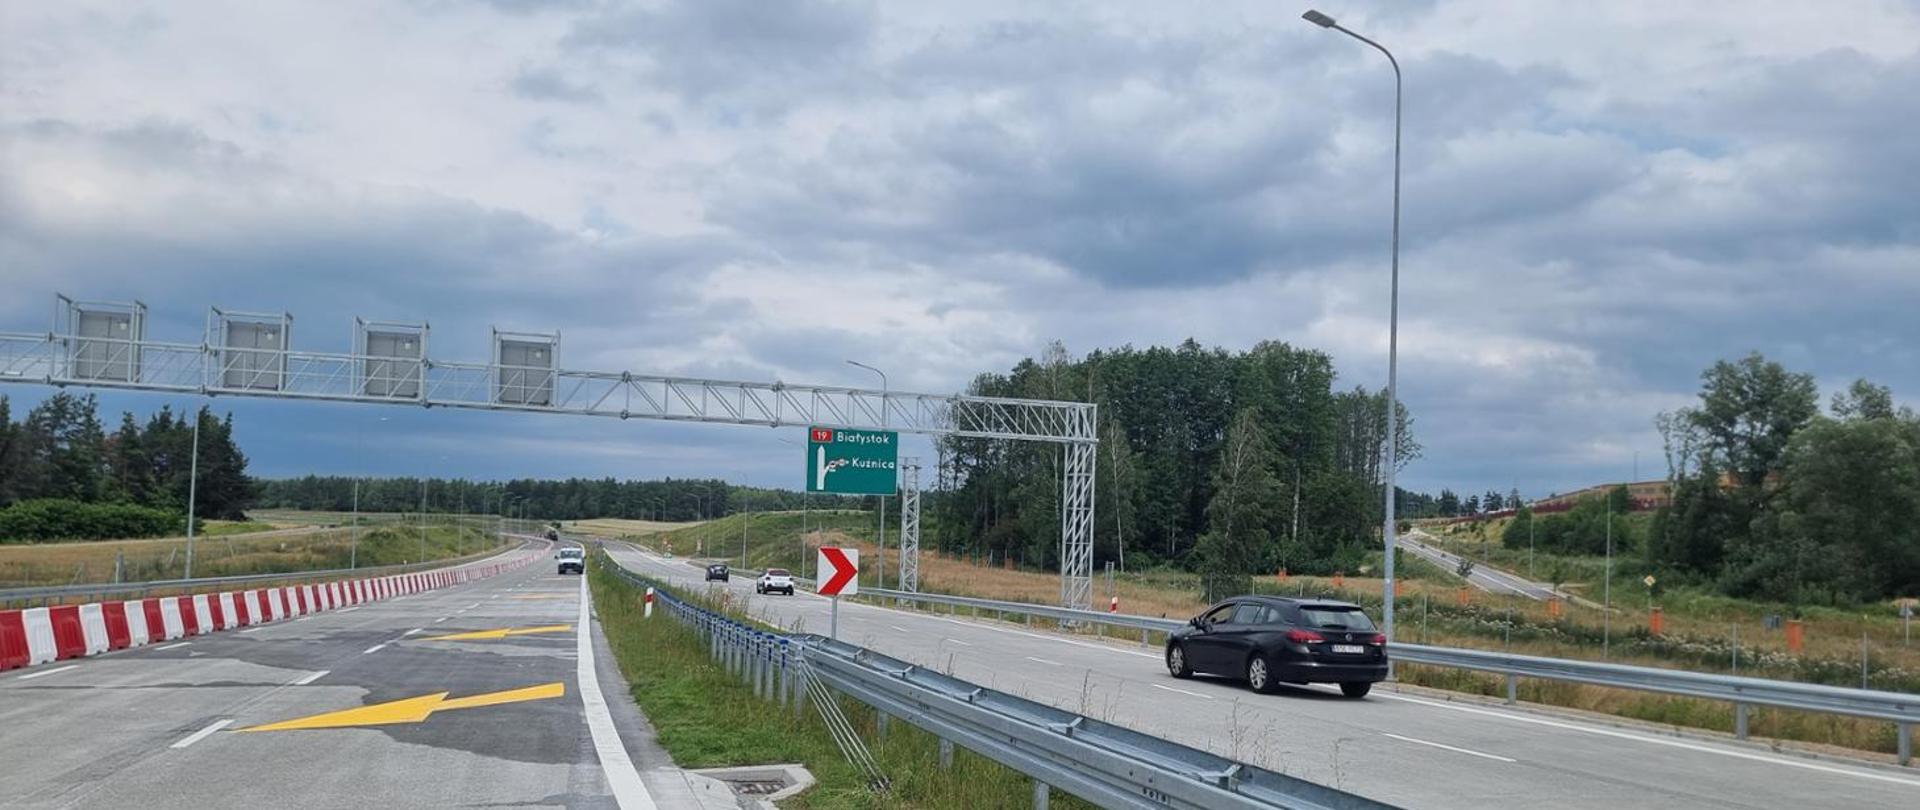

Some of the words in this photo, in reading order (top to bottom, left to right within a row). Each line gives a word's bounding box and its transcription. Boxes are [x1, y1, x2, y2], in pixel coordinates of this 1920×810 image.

[817, 431, 828, 440] 19
[837, 431, 889, 444] Białystok
[852, 457, 895, 469] Kuźnica
